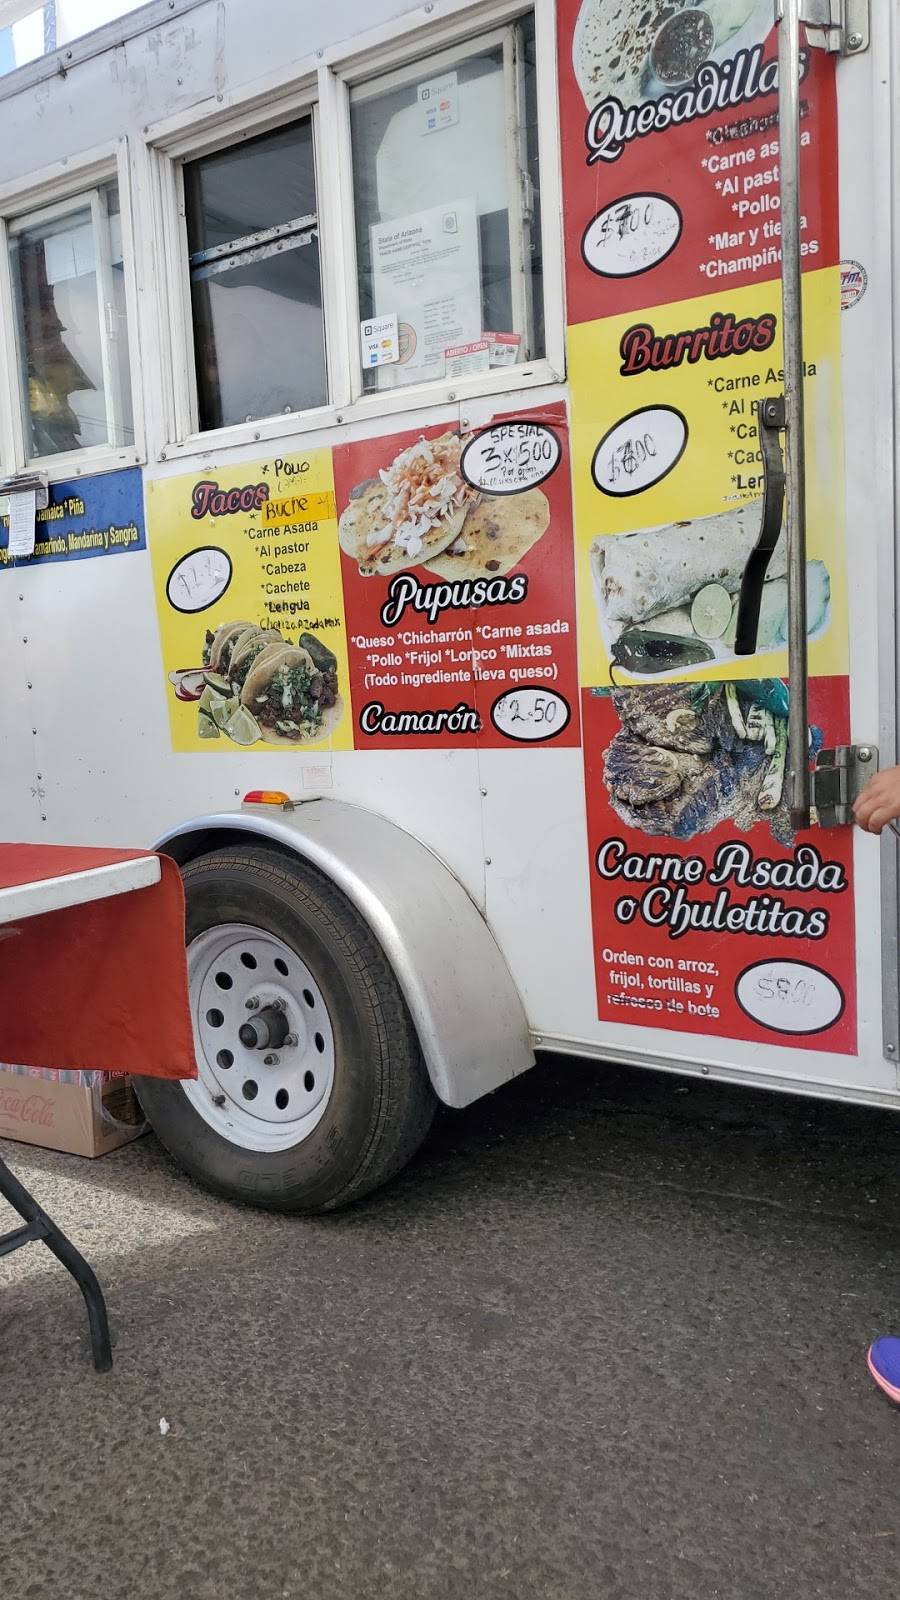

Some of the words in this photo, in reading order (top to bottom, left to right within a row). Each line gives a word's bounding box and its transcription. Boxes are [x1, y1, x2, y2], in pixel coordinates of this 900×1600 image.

[760, 131, 810, 159] asa
[743, 165, 780, 194] past
[749, 227, 759, 247] y
[763, 216, 807, 238] tiea
[699, 240, 819, 278] Champiñes
[373, 322, 394, 334] Square
[472, 342, 489, 352] OPEN
[621, 314, 776, 375] Burritos
[765, 362, 816, 384] Asa
[192, 482, 269, 519] Tacos
[34, 537, 68, 556] amarindo,
[103, 532, 109, 548] y
[110, 523, 138, 546] Sangría
[283, 521, 318, 535] Asada
[274, 542, 310, 558] pastor
[382, 574, 527, 626] Pupusas
[526, 619, 569, 636] asada
[364, 672, 397, 689] (Todo
[401, 667, 470, 687] ingrediente
[509, 663, 558, 683] queso)
[361, 703, 480, 734] Camarón
[597, 839, 703, 881] Carne
[709, 843, 846, 889] Asada
[616, 896, 638, 923] o
[642, 887, 827, 938] Chuletitas
[602, 948, 644, 966] Orden
[648, 954, 674, 969] con
[678, 957, 720, 977] arroz,
[610, 970, 644, 989] frijol,
[648, 973, 701, 995] tortillas
[705, 983, 714, 998] y
[688, 1000, 720, 1018] bote
